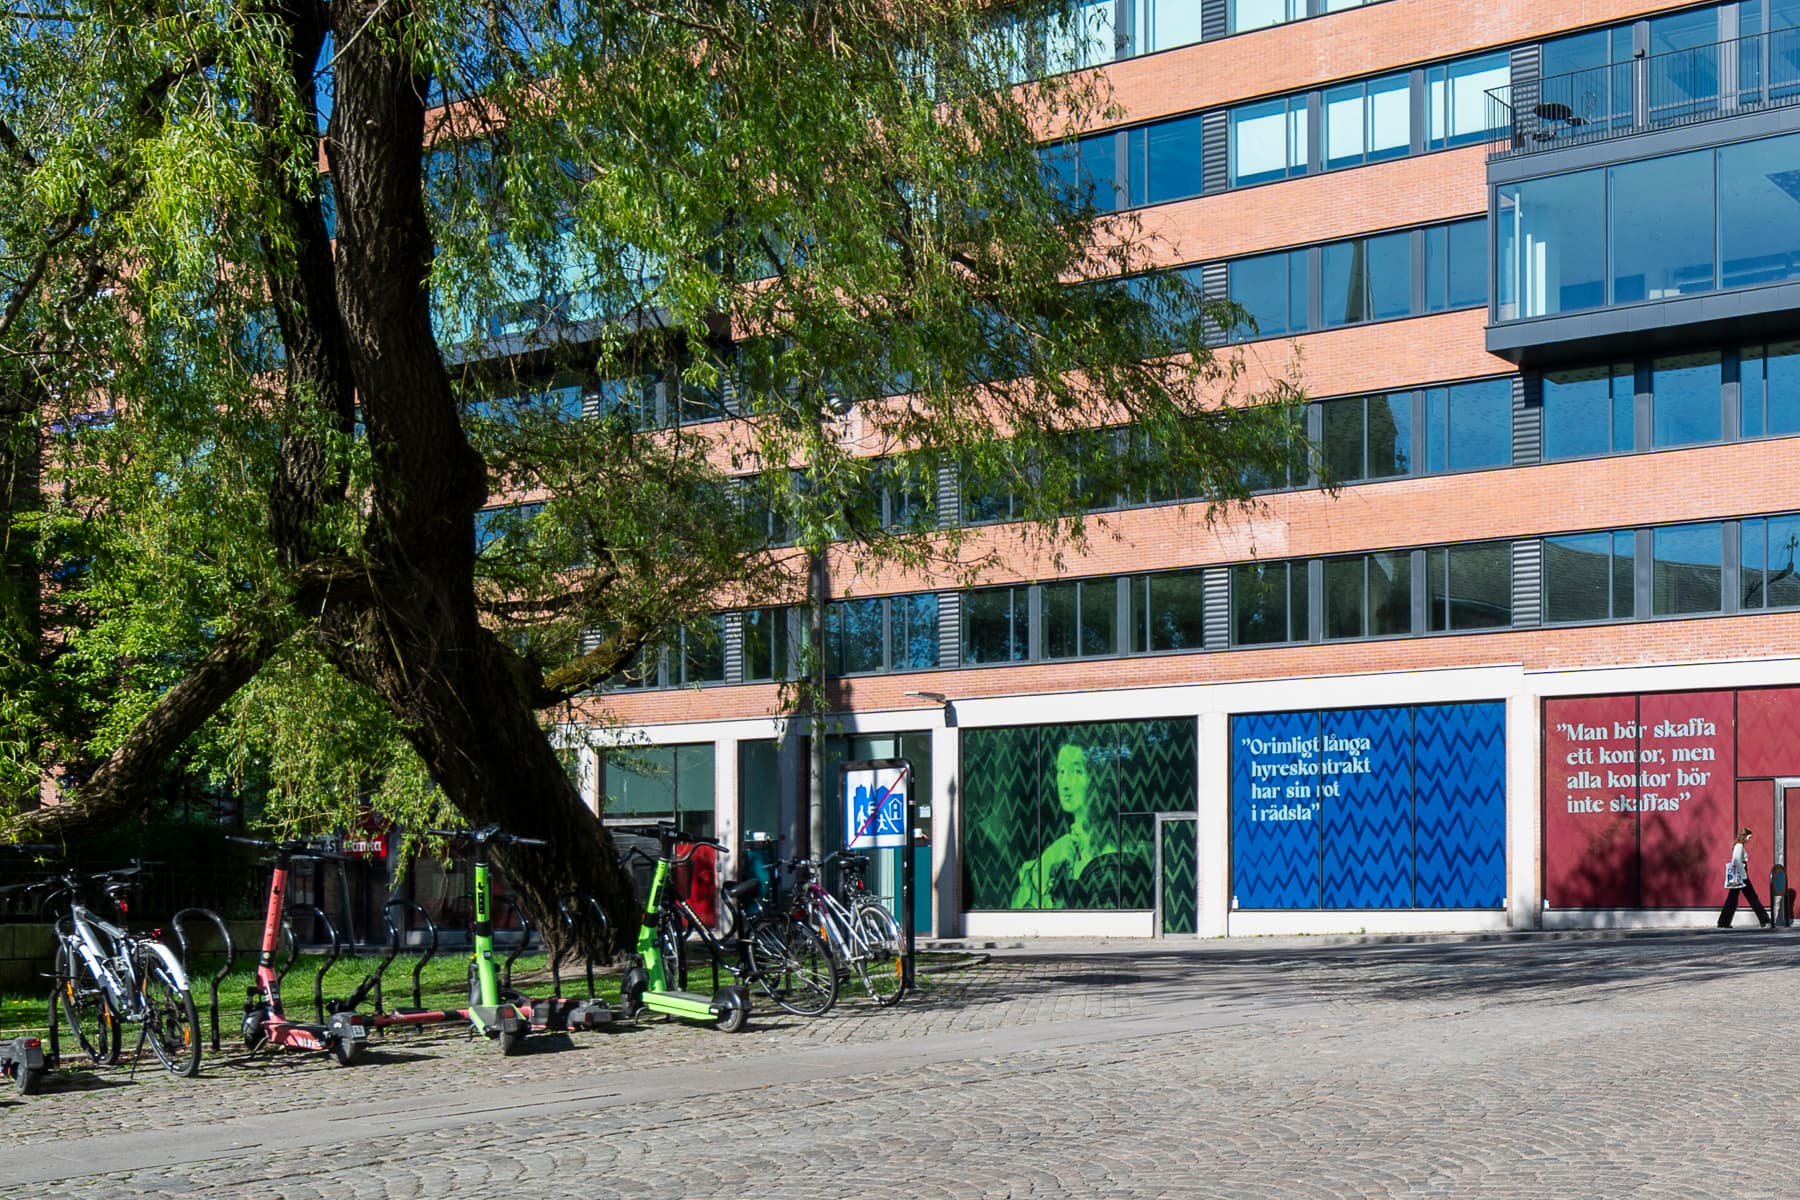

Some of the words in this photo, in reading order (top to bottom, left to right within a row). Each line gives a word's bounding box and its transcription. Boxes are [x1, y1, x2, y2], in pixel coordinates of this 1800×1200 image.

[1614, 721, 1648, 741] bör
[1653, 717, 1716, 738] skaffa
[1322, 733, 1371, 757] långa
[1566, 746, 1594, 766] ett
[1671, 745, 1716, 762] men
[1251, 756, 1372, 782] hyreskontrakt
[1566, 770, 1602, 790] alla
[1676, 767, 1711, 787] bör
[1251, 781, 1279, 800] har
[1285, 780, 1311, 799] sin
[1316, 780, 1341, 799] rot
[1251, 805, 1257, 822] i
[1566, 795, 1605, 814] inte
